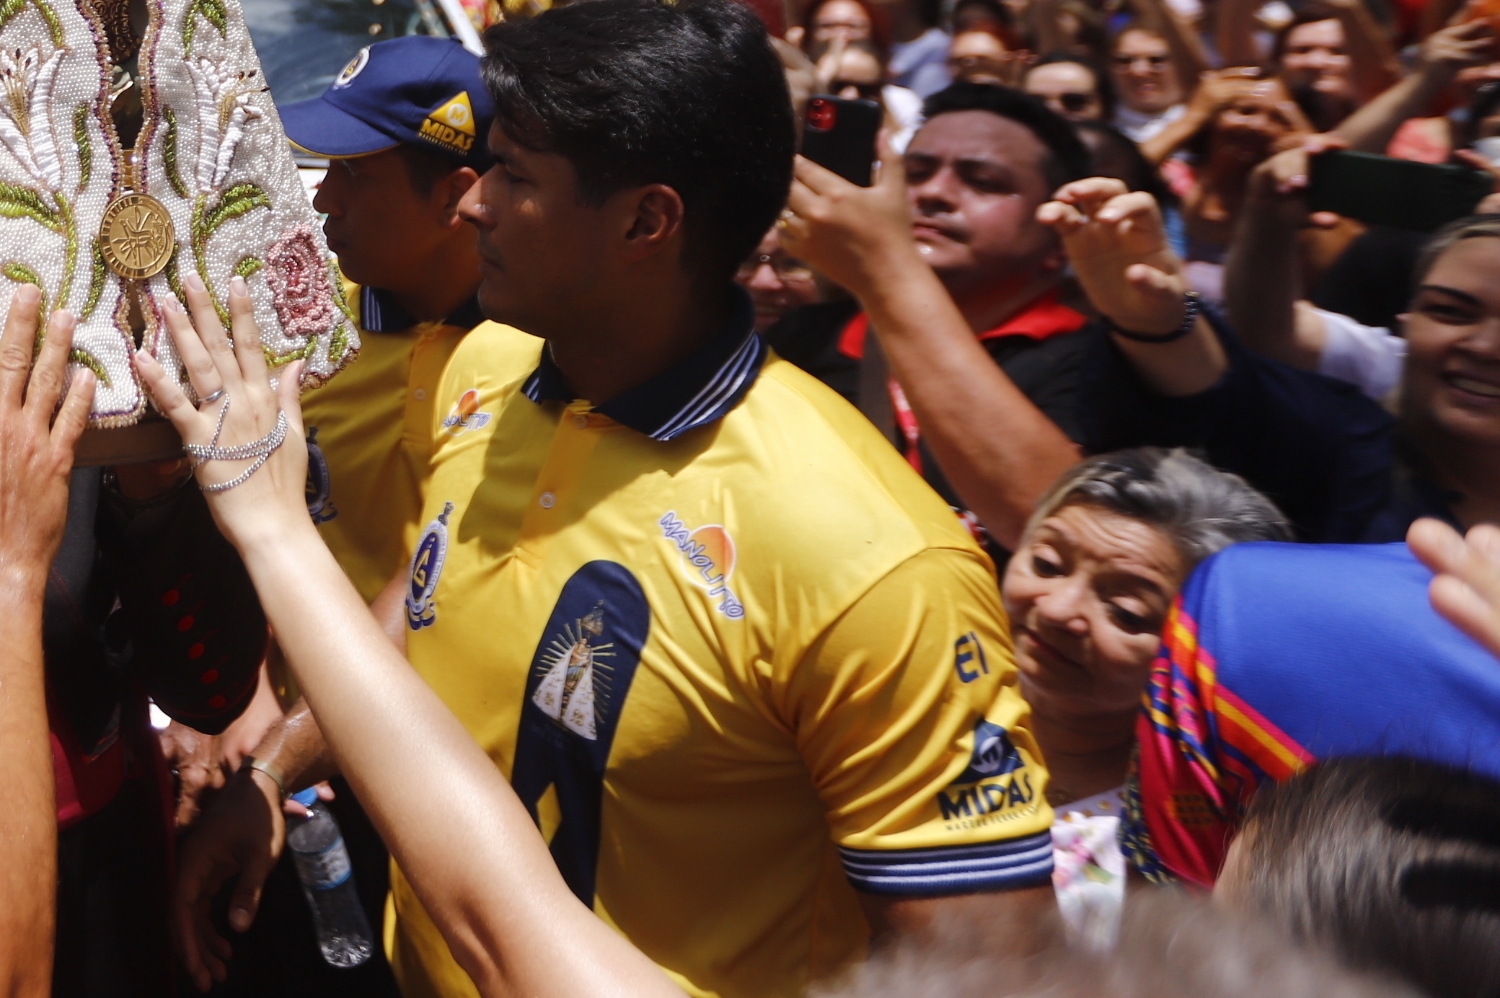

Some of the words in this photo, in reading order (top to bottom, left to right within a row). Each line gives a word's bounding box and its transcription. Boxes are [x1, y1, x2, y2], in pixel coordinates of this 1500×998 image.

[421, 118, 474, 150] MIDAS
[660, 512, 744, 618] MANOLITO
[938, 772, 1034, 820] MIDAS
